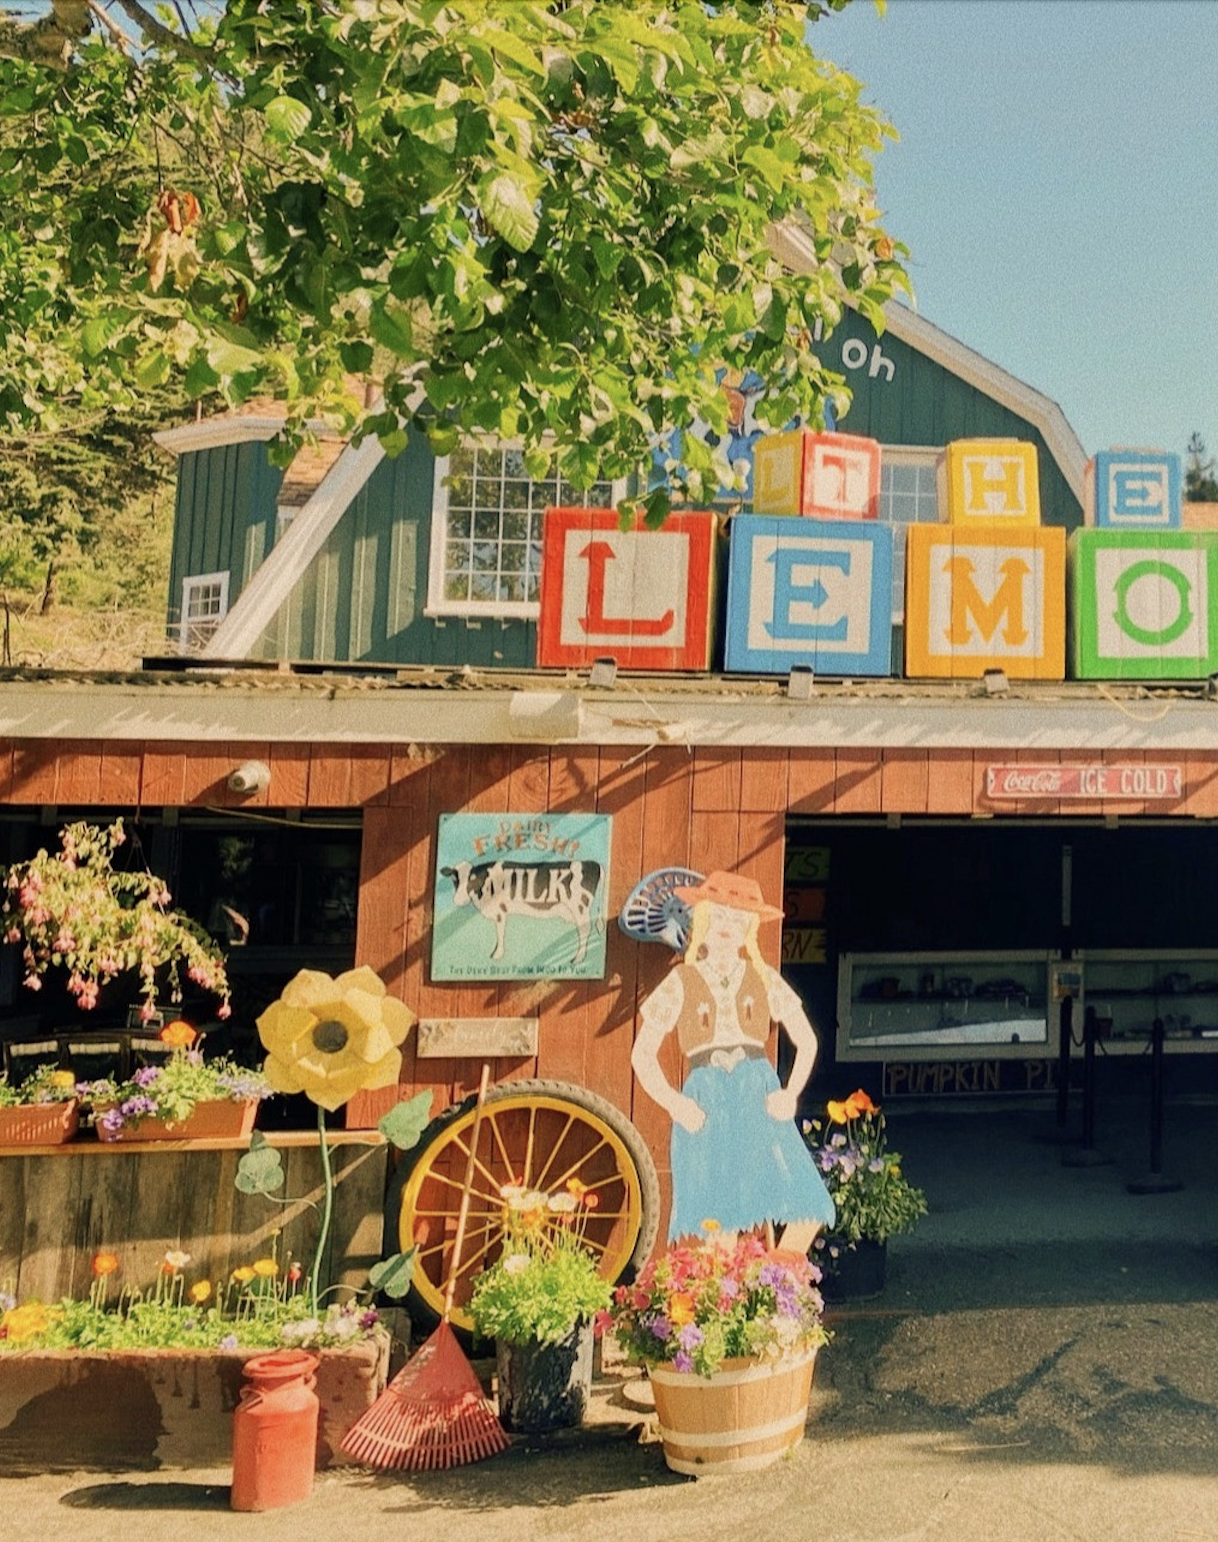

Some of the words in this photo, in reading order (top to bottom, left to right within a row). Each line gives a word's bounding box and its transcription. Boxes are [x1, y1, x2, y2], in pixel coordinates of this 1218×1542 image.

[1080, 769, 1108, 794] ICE
[1121, 769, 1167, 794] COLD
[478, 867, 571, 902] MILK
[887, 1061, 1000, 1094] PUMPKIN
